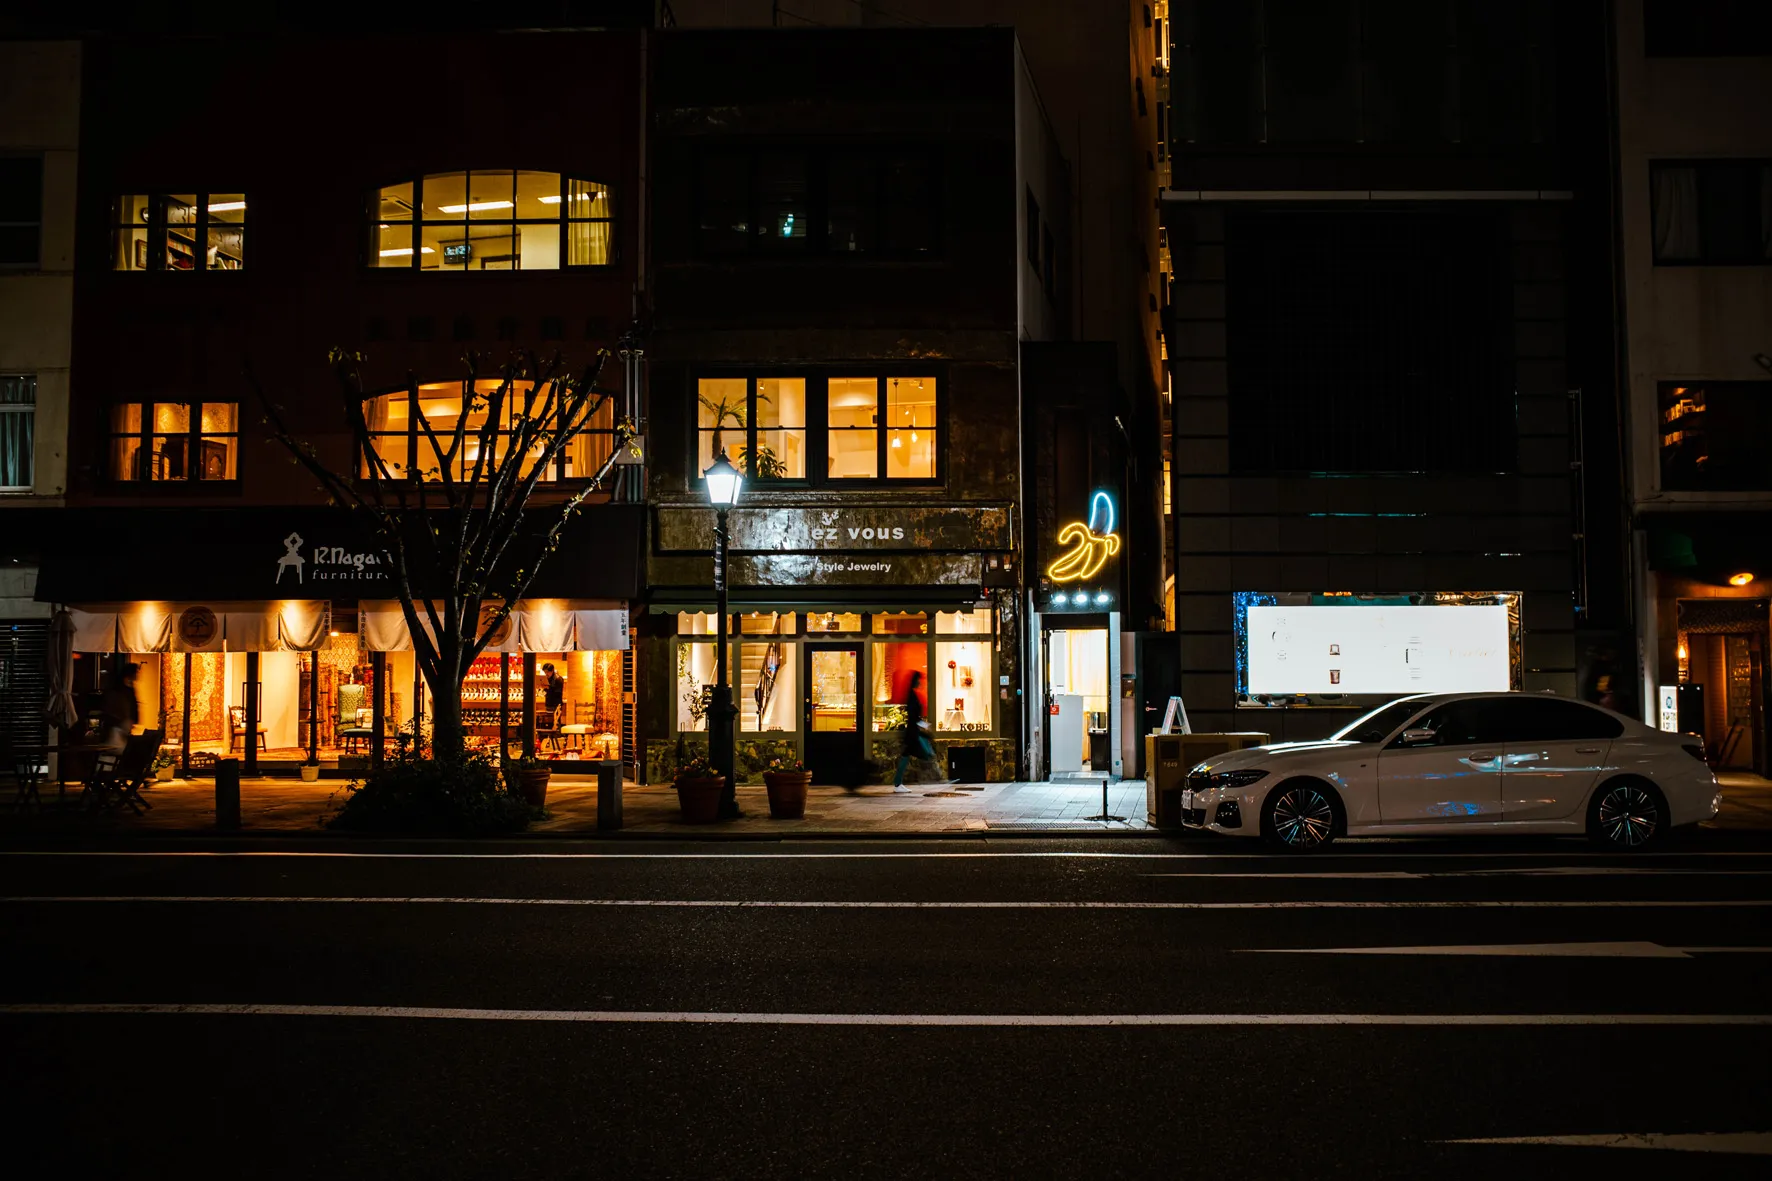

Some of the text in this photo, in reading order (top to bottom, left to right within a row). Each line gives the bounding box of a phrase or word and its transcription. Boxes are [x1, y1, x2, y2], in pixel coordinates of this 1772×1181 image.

[847, 527, 905, 540] vous
[816, 562, 845, 573] Style
[847, 562, 892, 573] Jewelry
[960, 723, 990, 731] KOBE
